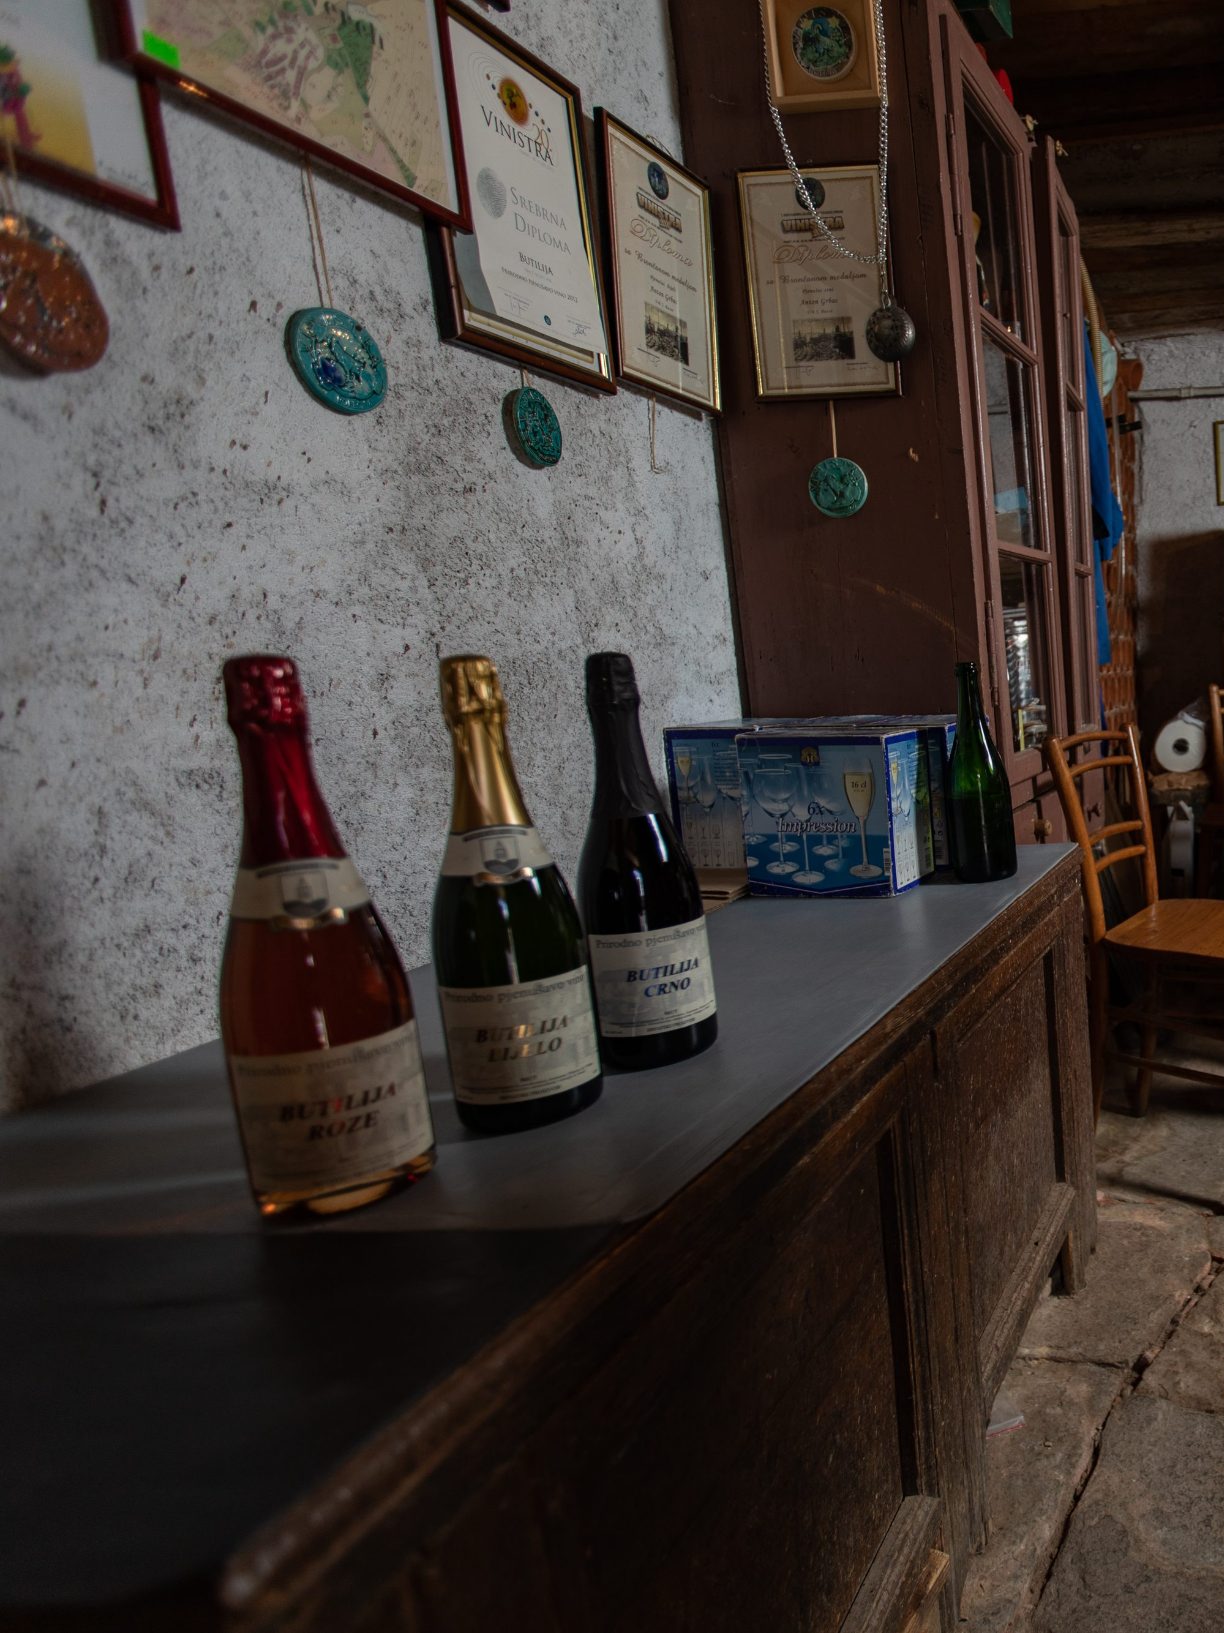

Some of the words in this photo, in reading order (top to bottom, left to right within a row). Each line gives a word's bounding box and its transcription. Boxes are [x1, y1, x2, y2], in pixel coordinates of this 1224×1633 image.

[481, 104, 554, 166] VINISTRA
[629, 218, 693, 268] Diploma
[519, 251, 553, 276] BUTILIJA
[776, 817, 857, 836] Impression
[626, 957, 700, 982] BUTILIJA
[643, 977, 691, 998] CRNO
[475, 1014, 568, 1043] BUTILIJA
[278, 1081, 396, 1123] BUTILIJA
[306, 1110, 380, 1142] ROZE
